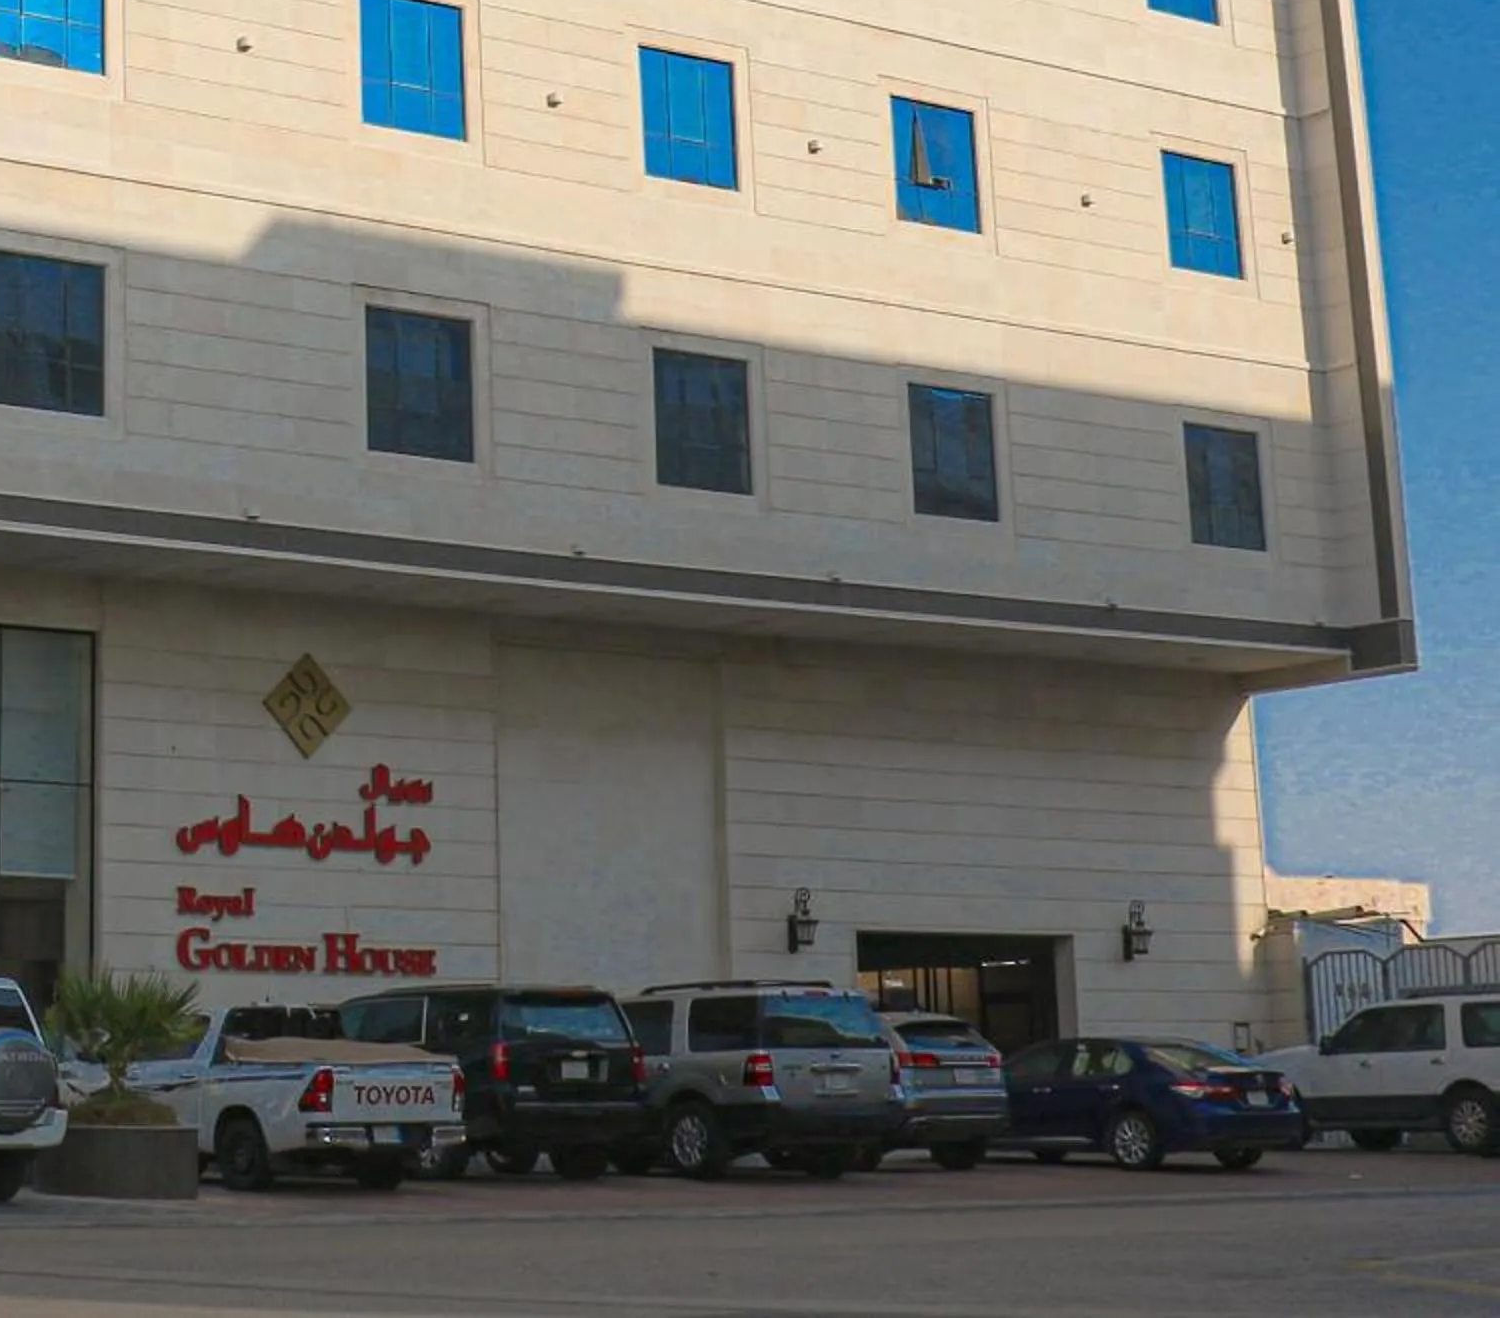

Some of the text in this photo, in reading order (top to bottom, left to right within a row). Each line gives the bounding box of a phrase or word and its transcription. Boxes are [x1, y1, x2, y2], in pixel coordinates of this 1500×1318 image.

[177, 886, 256, 921] Royal
[176, 927, 437, 976] GOLDEN HOUSE
[353, 1085, 435, 1105] TOYOTA
